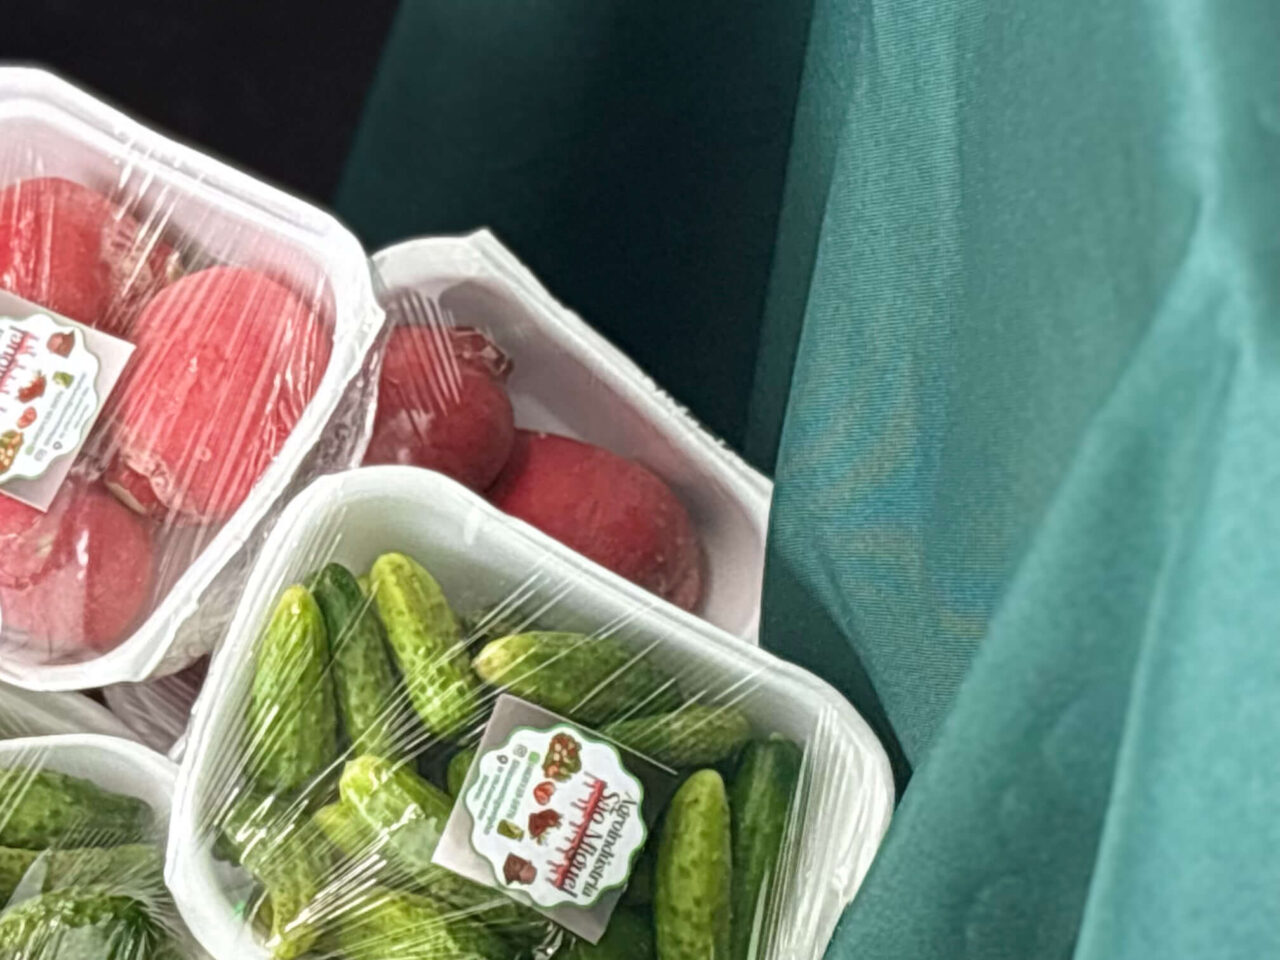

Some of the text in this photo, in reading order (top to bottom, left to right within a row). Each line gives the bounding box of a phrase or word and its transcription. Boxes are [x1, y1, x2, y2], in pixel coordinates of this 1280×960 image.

[558, 789, 621, 898] São Miguel
[580, 791, 638, 899] Agroindústria
